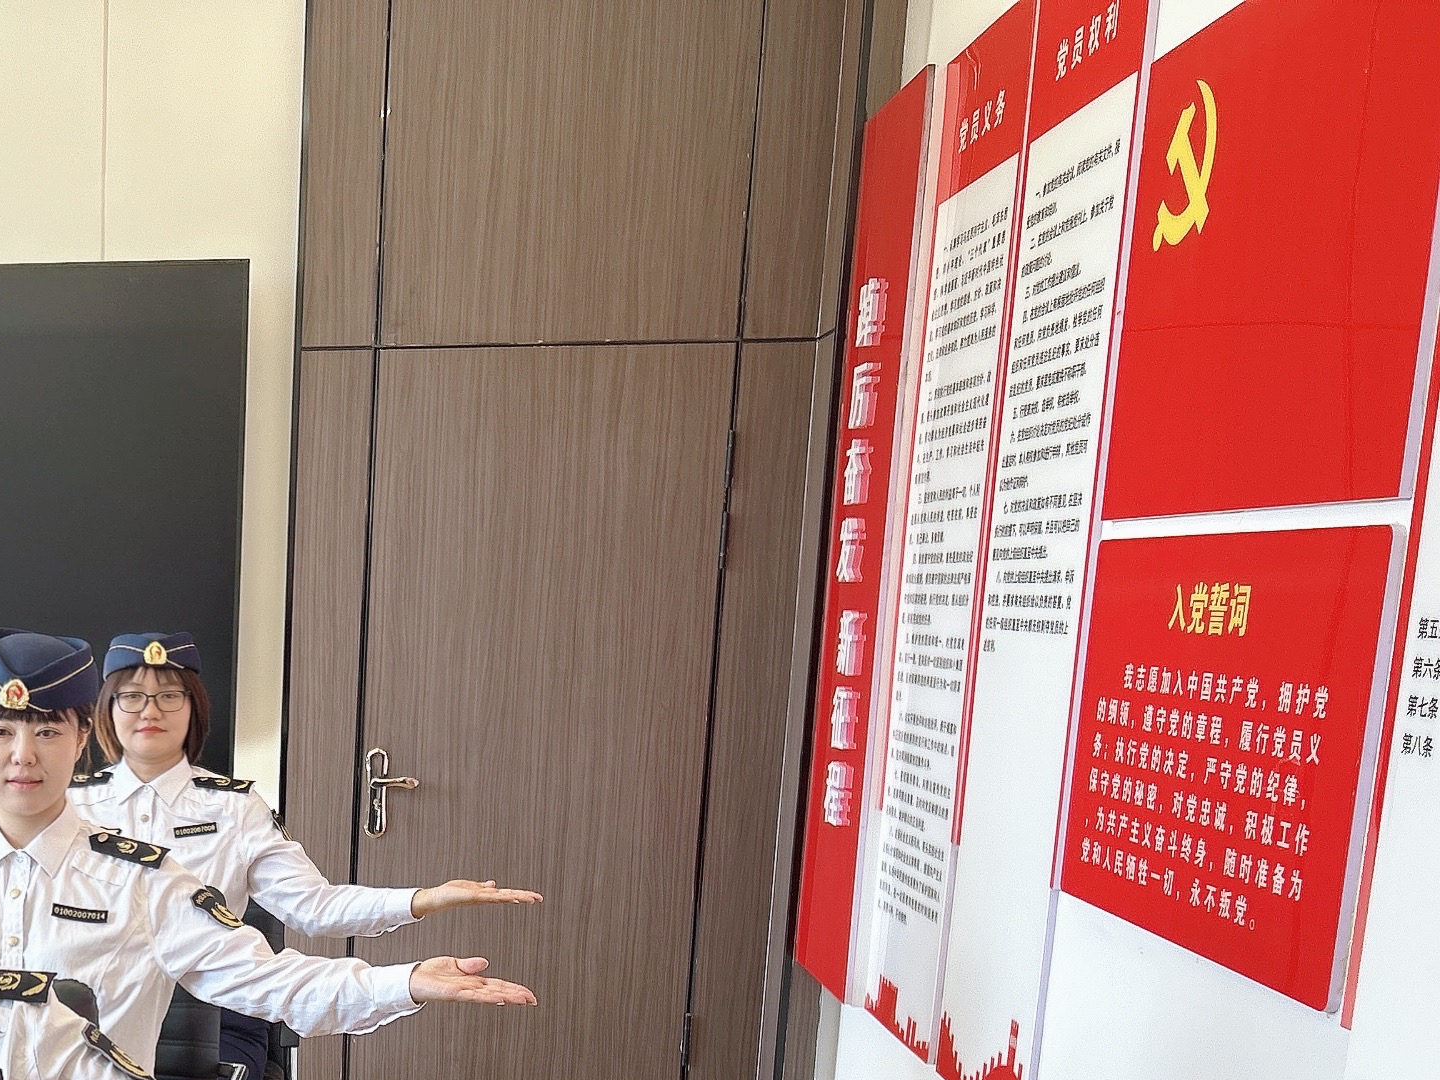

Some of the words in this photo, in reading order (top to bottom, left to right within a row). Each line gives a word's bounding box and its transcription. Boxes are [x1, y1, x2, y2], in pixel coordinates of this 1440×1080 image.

[1055, 0, 1120, 81] 党员权利
[958, 90, 1006, 154] 党员义务
[1167, 582, 1252, 636] 入党誓词
[1417, 617, 1440, 639] 第五
[1406, 695, 1439, 719] 第七条
[1401, 733, 1433, 757] 第八条
[54, 906, 106, 920] 01002007014
